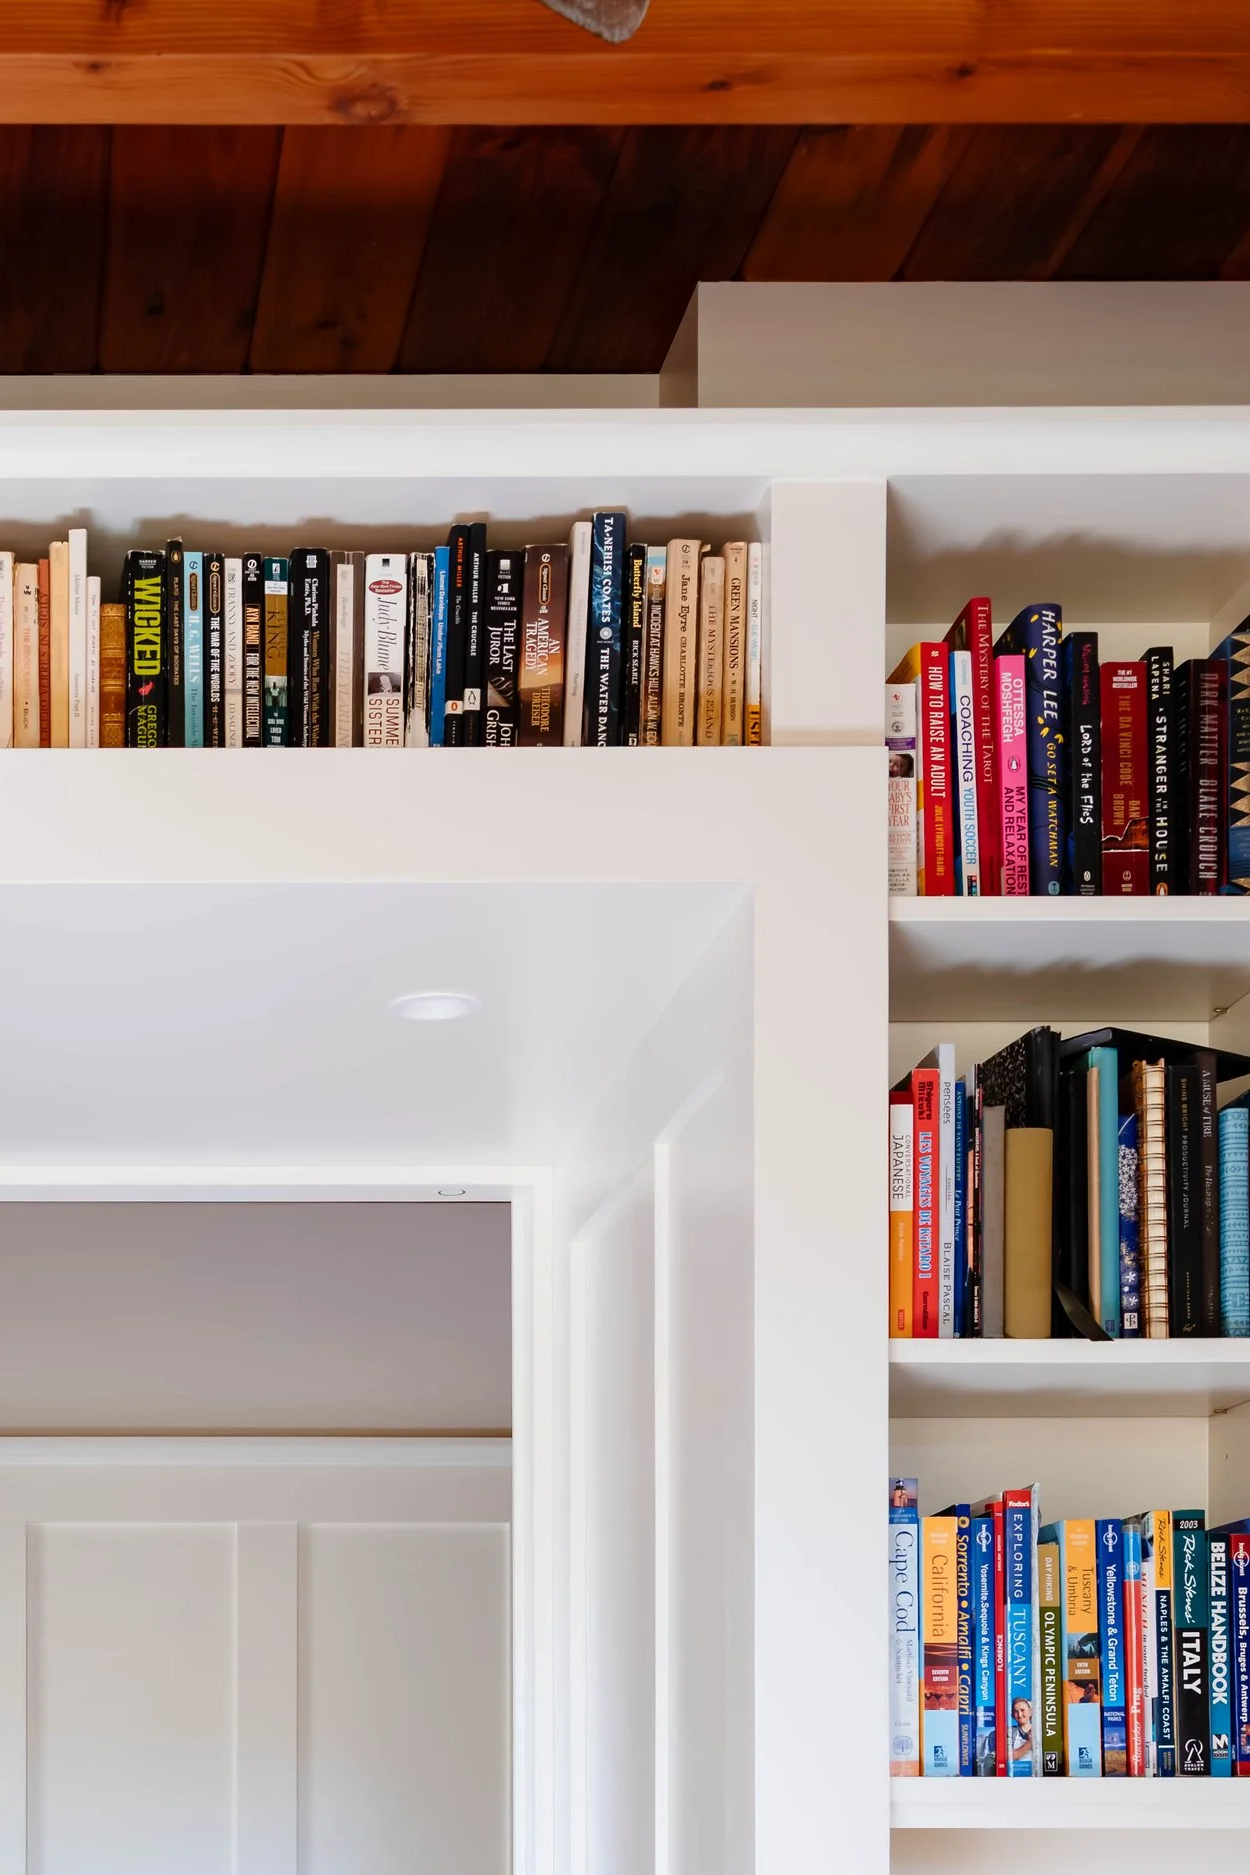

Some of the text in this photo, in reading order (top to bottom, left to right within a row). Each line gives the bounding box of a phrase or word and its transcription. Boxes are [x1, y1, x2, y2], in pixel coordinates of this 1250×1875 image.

[601, 578, 611, 623] COATES
[631, 559, 642, 628] Butterfly Island
[680, 575, 690, 632] Jane Eyre
[729, 577, 741, 670] GREEN MANSIONS
[134, 576, 161, 676] WICKED
[246, 608, 260, 645] AYN RAND
[487, 625, 503, 665] JUROR
[502, 620, 517, 672] THE LAST
[525, 622, 538, 671] TRAGEDY
[537, 618, 549, 676] AMERICAN
[599, 648, 610, 710] THE WATER
[1041, 610, 1058, 720] HARPER LEE
[928, 666, 946, 798] HOW TO RAISE AN ADULT
[1002, 672, 1013, 743] MOSHFEGH
[1013, 679, 1024, 736] OTTESSA
[959, 695, 976, 865] COACHING YOUTH SOCCER
[1155, 716, 1167, 794] STRANGER
[1155, 816, 1168, 872] HOUSE
[893, 1135, 904, 1200] JAPANESE
[943, 1242, 951, 1325] BLAISE PASCAL
[1180, 1521, 1198, 1529] 2003
[890, 1531, 916, 1632] Cape Cod
[931, 1554, 949, 1638] California
[1013, 1514, 1026, 1688] EXPLORING TUSCANY
[1082, 1568, 1094, 1614] Tuscany
[957, 1534, 973, 1716] Sorrento Amalfi Capri
[1106, 1564, 1118, 1702] Yellowstone & Grand Teton
[1159, 1595, 1168, 1633] NAPLES
[1211, 1542, 1228, 1705] BELIZE HANDBOOK
[1044, 1611, 1056, 1737] OLYMPIC PENINSULA
[1160, 1647, 1169, 1665] THE
[1161, 1668, 1169, 1705] AMALFI
[1182, 1631, 1201, 1695] ITALY
[1162, 1708, 1171, 1739] COAST
